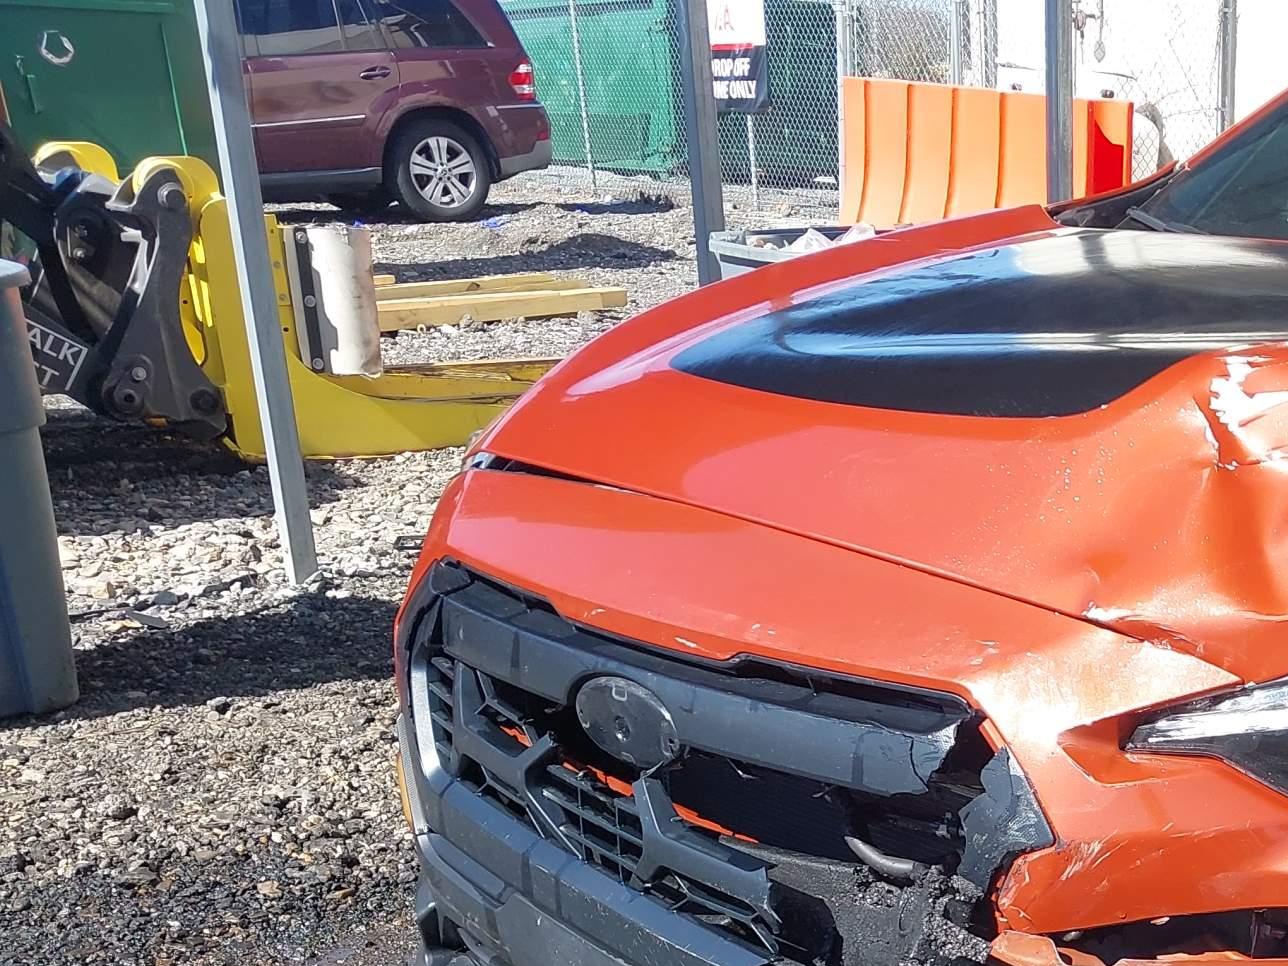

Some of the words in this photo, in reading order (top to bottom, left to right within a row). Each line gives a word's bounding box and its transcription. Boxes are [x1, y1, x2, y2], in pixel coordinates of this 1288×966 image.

[733, 57, 751, 77] OFF
[729, 80, 757, 99] ONLY
[27, 326, 81, 366] ALK
